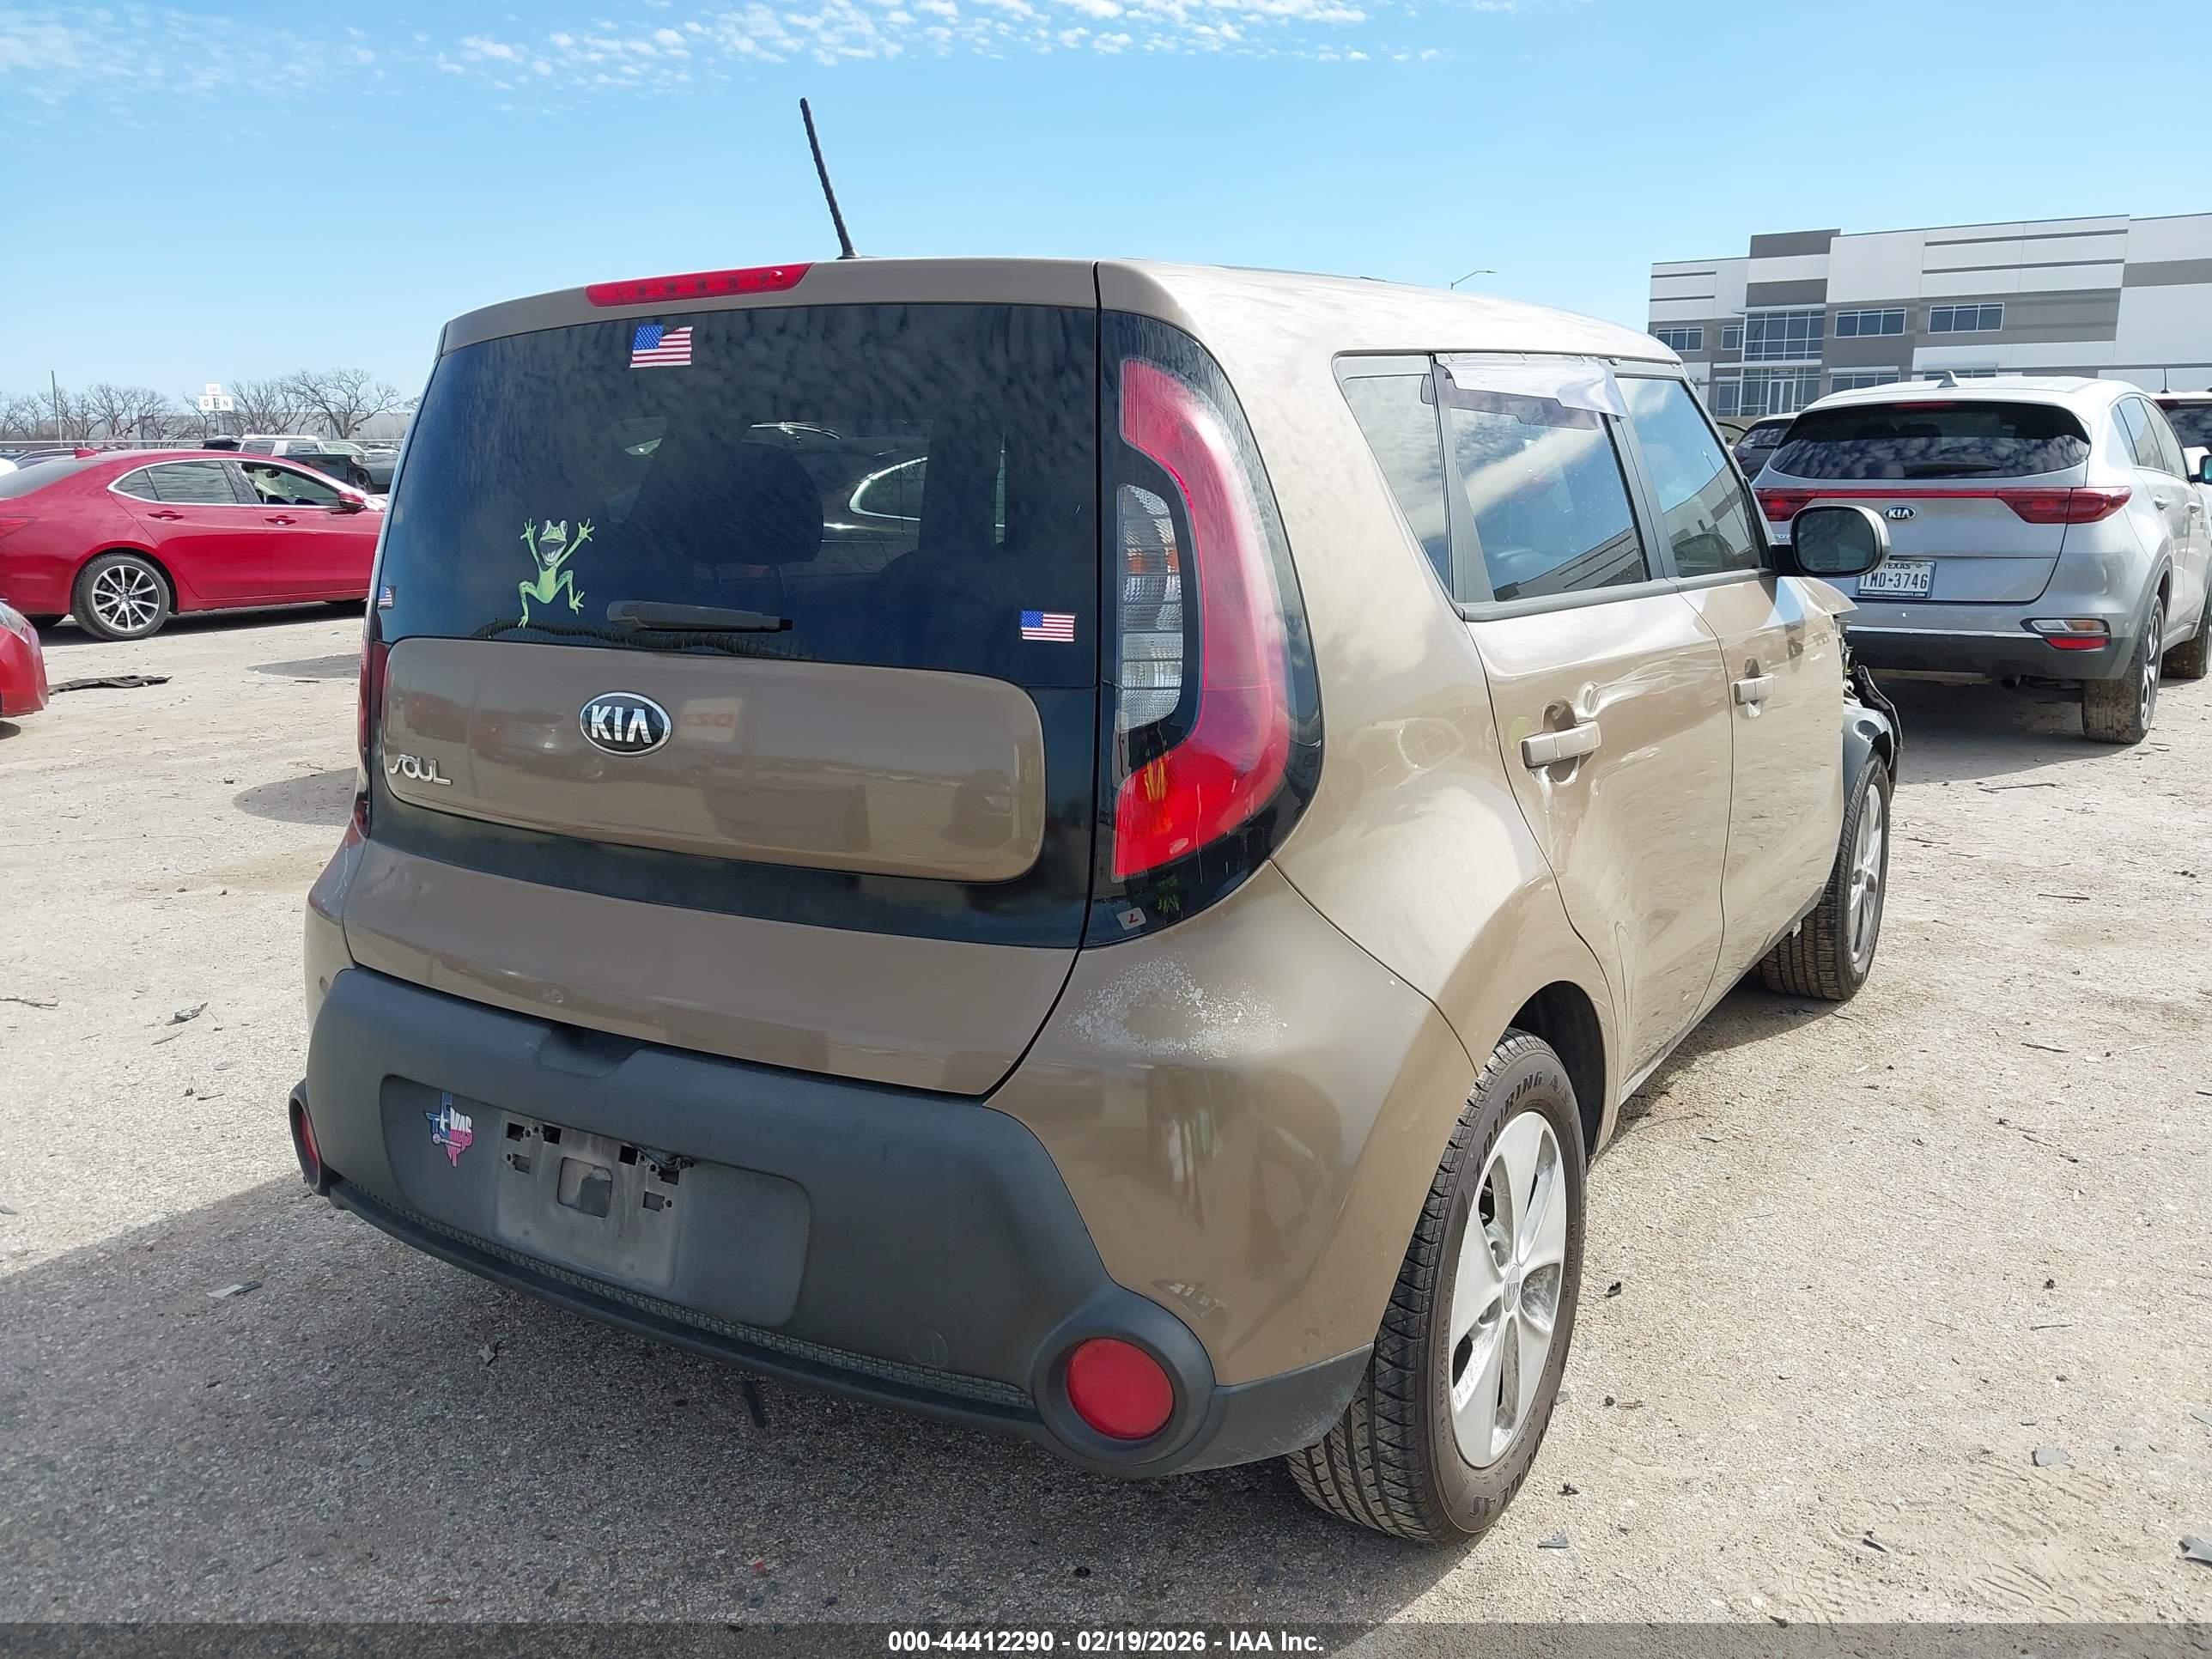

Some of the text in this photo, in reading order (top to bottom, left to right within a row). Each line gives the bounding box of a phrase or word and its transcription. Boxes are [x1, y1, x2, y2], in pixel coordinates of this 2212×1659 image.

[1889, 508, 1911, 519] KIA
[591, 704, 653, 744] KIA
[389, 754, 452, 786] SOUL
[1473, 1071, 1544, 1179] TOURING
